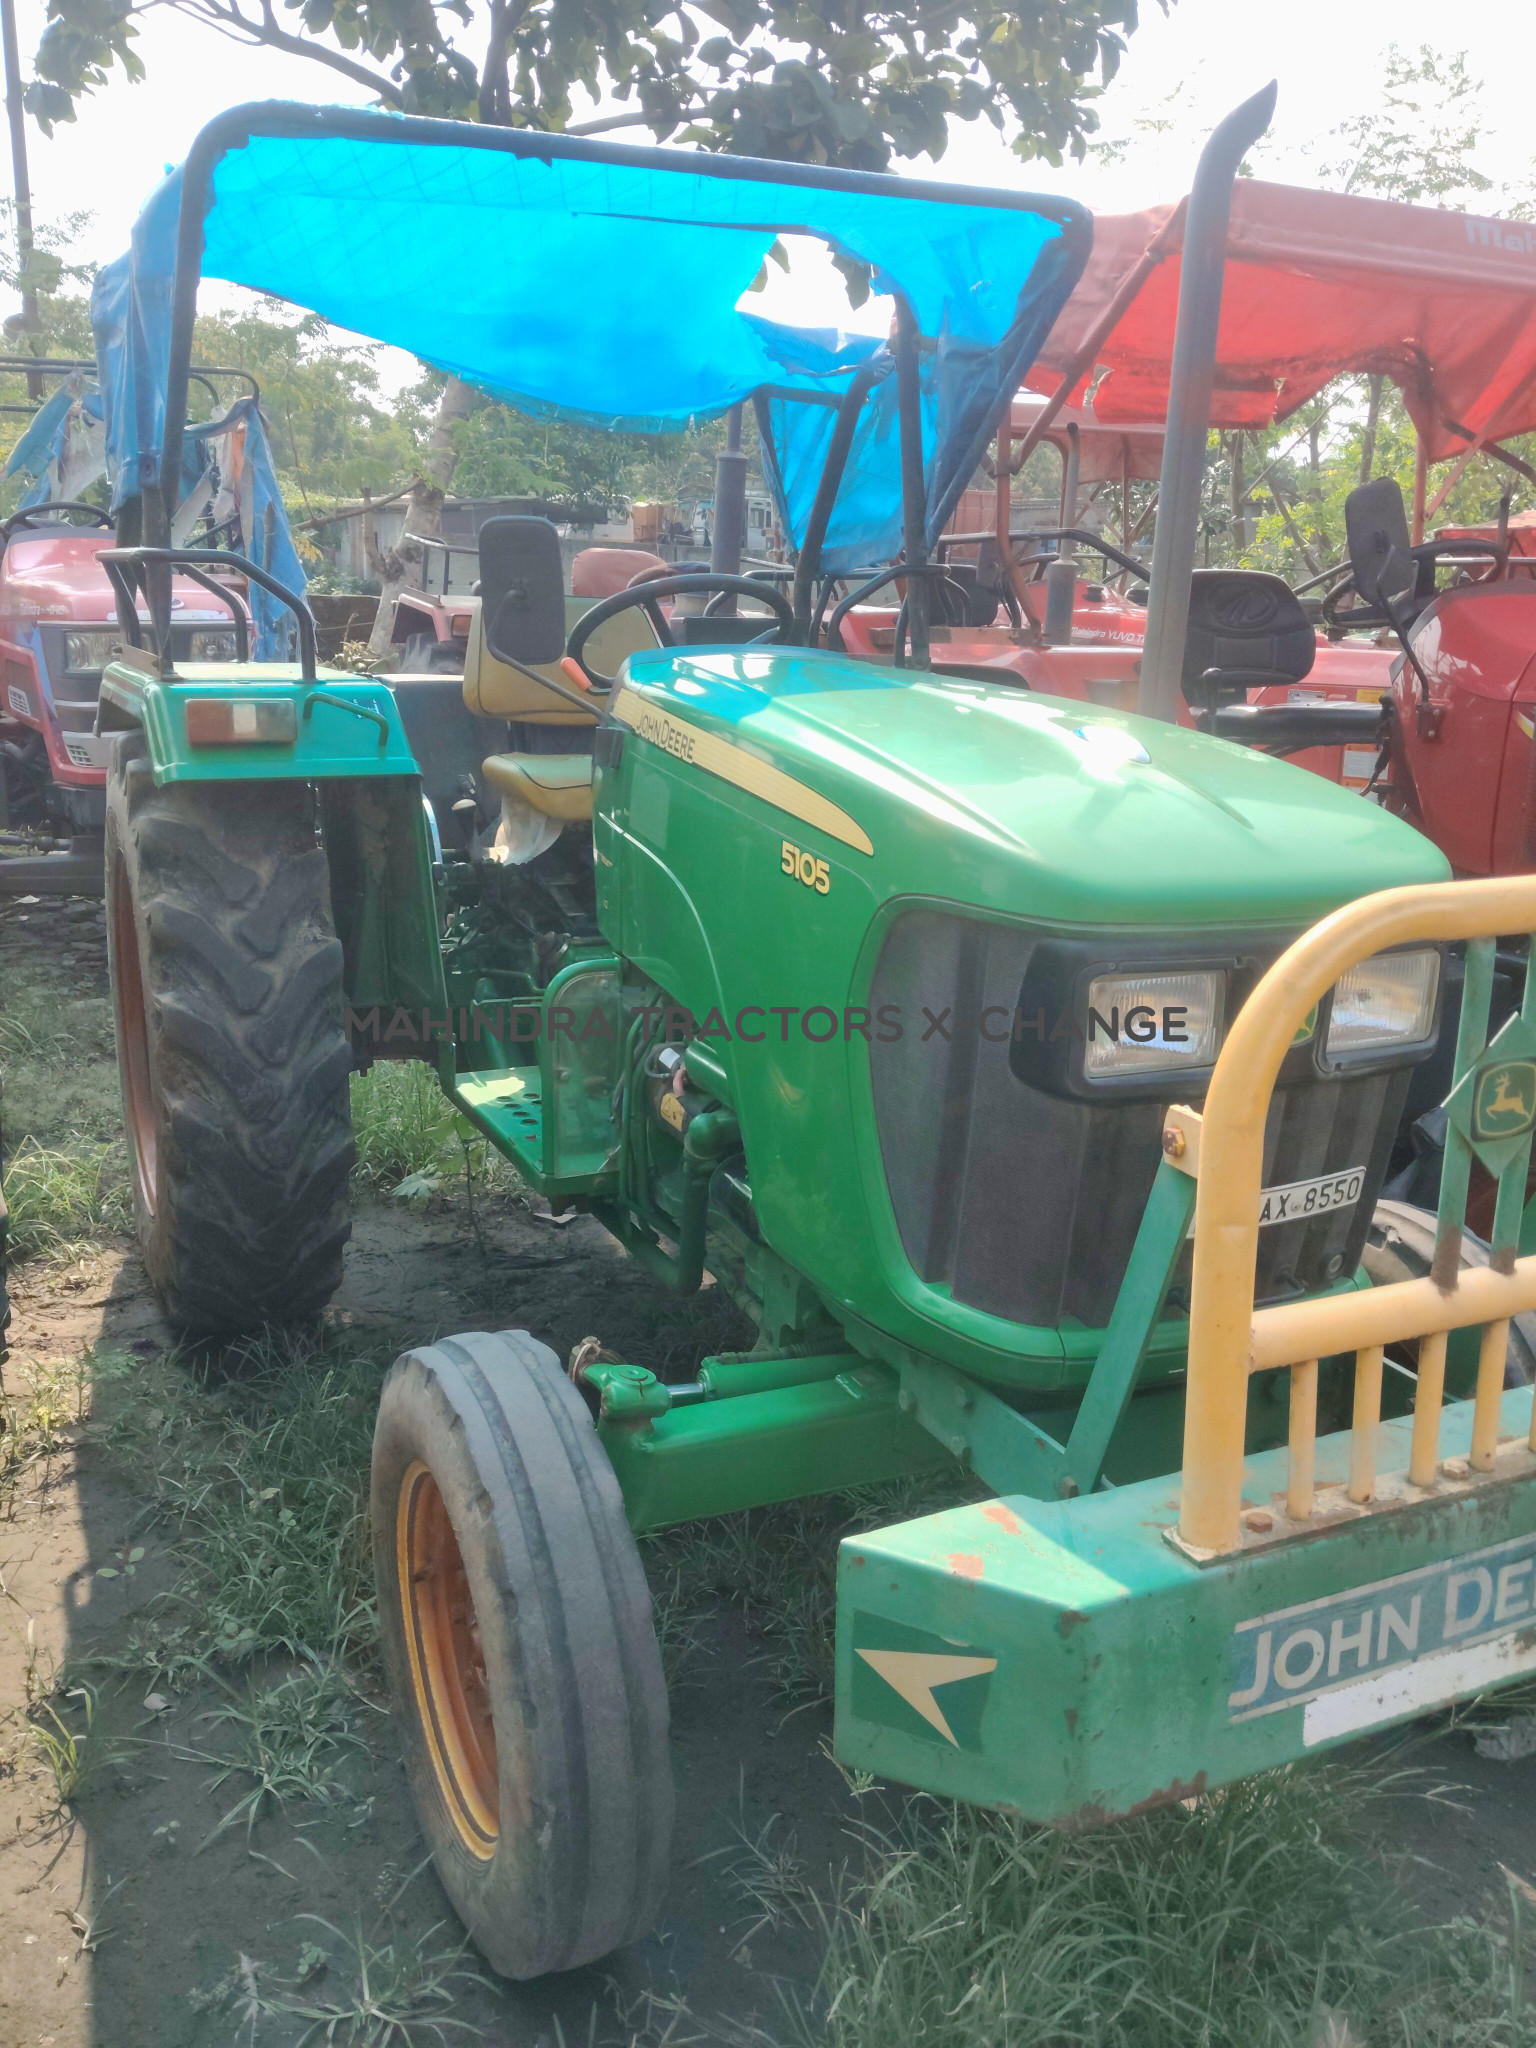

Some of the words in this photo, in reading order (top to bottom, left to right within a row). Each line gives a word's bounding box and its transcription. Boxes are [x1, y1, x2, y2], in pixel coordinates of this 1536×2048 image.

[1108, 630, 1135, 642] YUVO
[636, 710, 661, 744] JOHN
[660, 718, 696, 761] DEERE
[781, 839, 830, 895] 5105
[1259, 1192, 1291, 1223] AX
[1303, 1175, 1360, 1213] 8550
[1228, 1595, 1421, 1707] JOHN
[1442, 1558, 1536, 1639] DE
